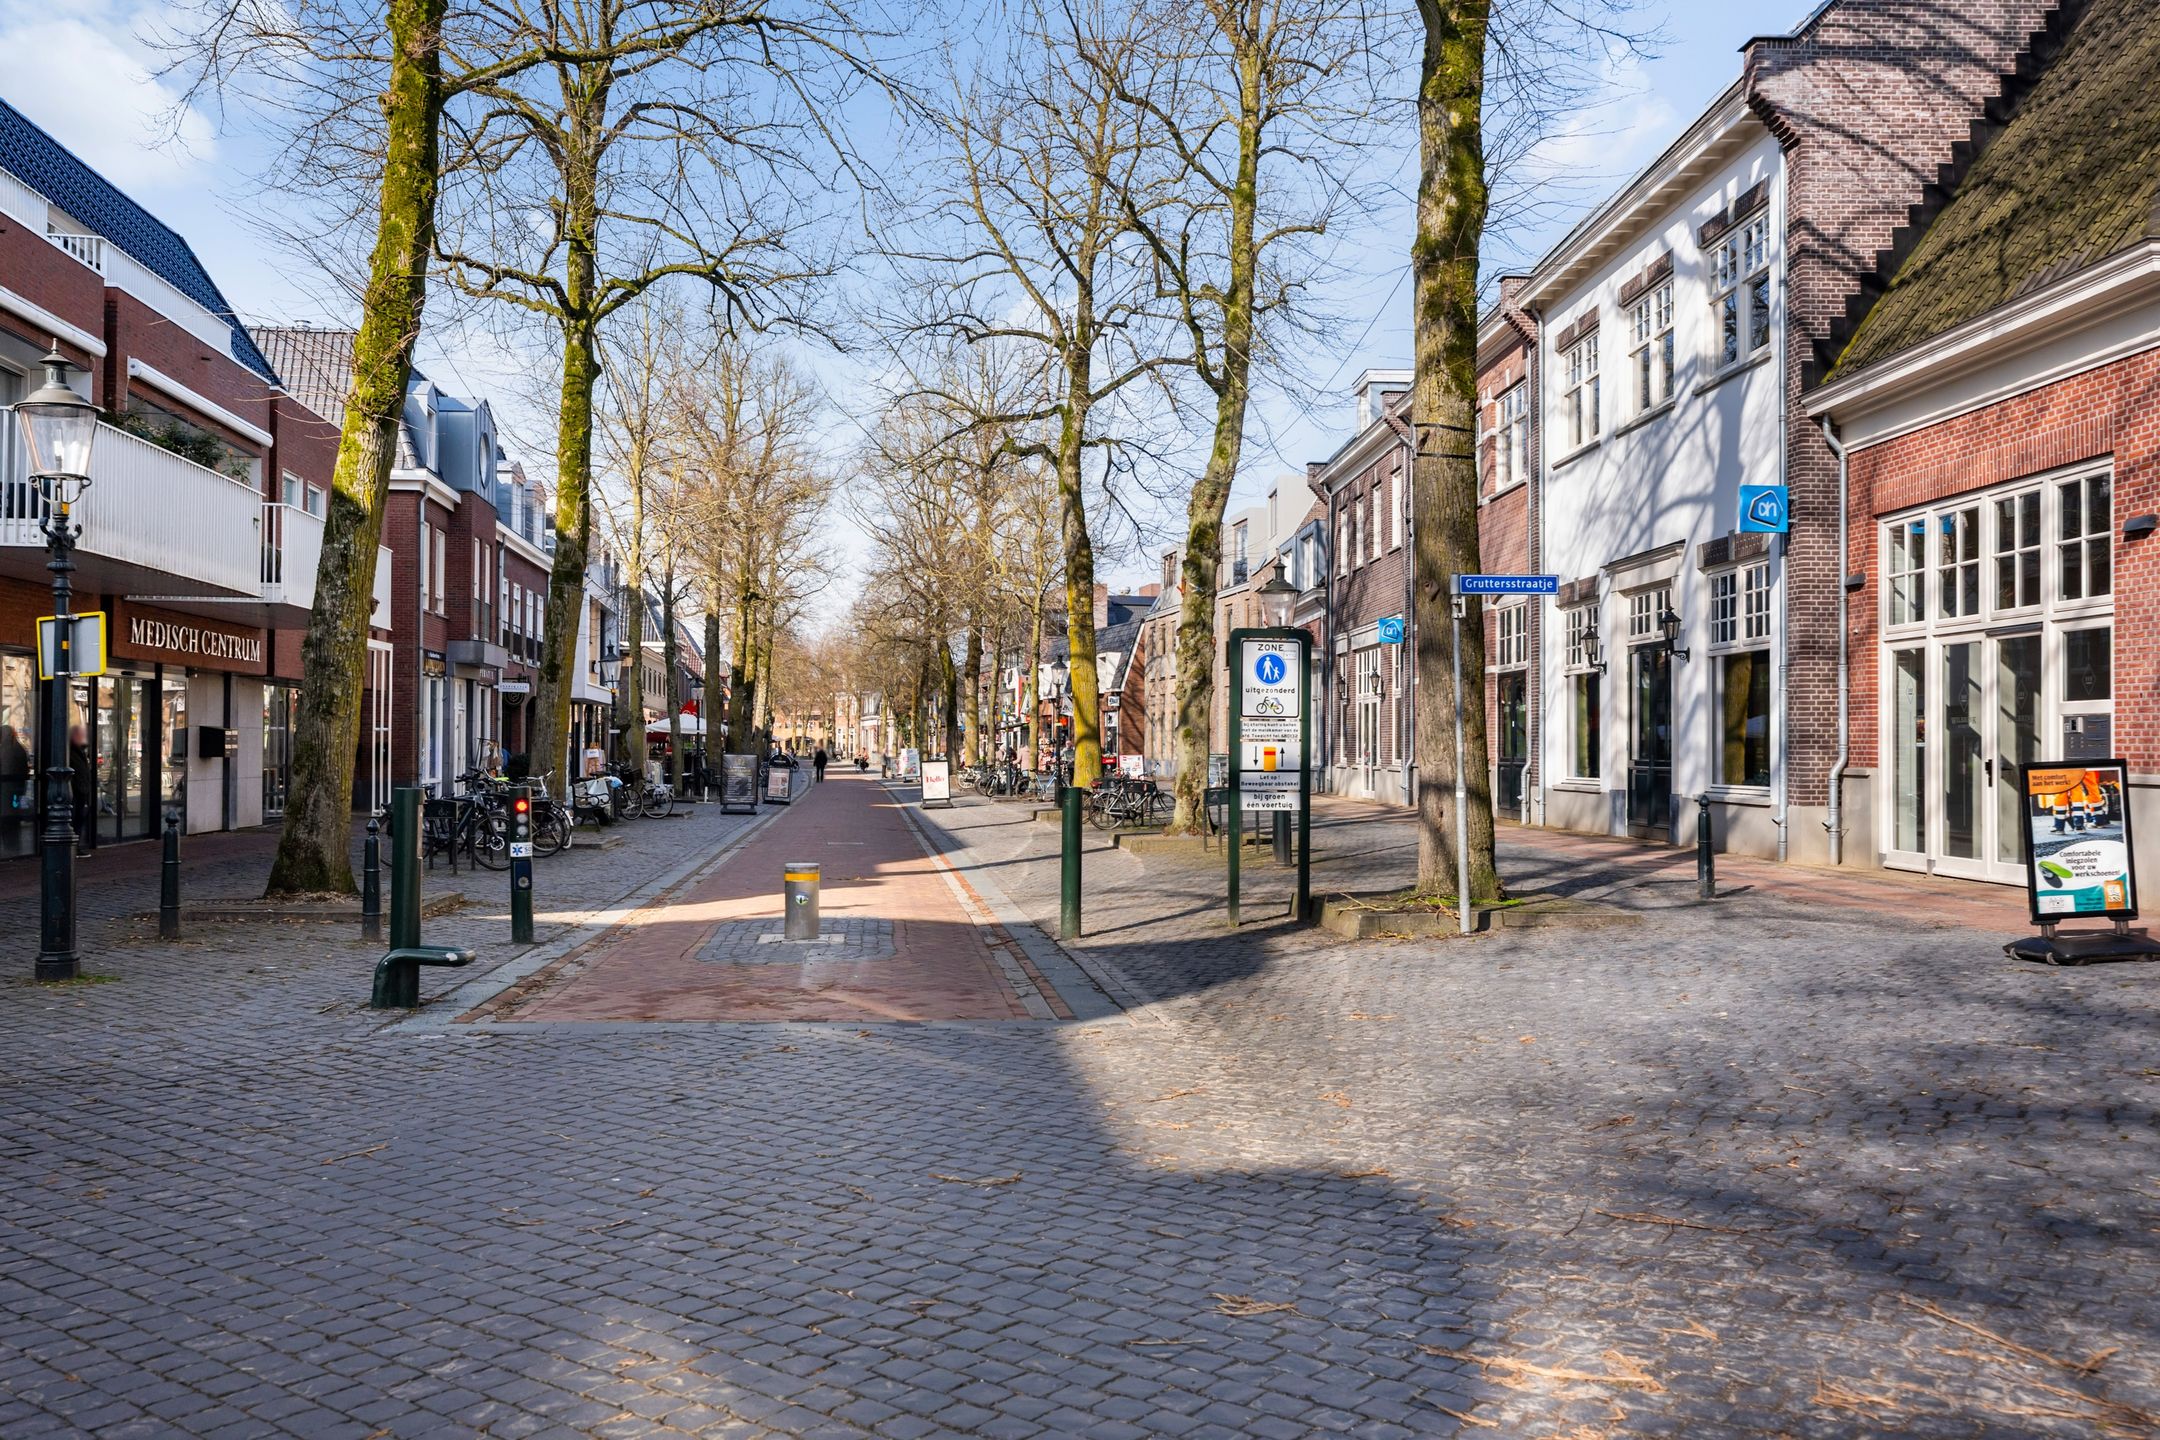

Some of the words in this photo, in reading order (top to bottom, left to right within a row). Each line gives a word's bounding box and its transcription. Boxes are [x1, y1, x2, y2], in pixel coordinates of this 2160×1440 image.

[1465, 579, 1553, 590] Gruttersstraatje
[130, 617, 199, 653] MEDISCH
[201, 630, 261, 662] CENTRUM
[1257, 643, 1284, 652] ZONE
[1245, 686, 1296, 695] uitgezonderd
[1253, 793, 1263, 801] bij
[1262, 801, 1293, 809] voertuig
